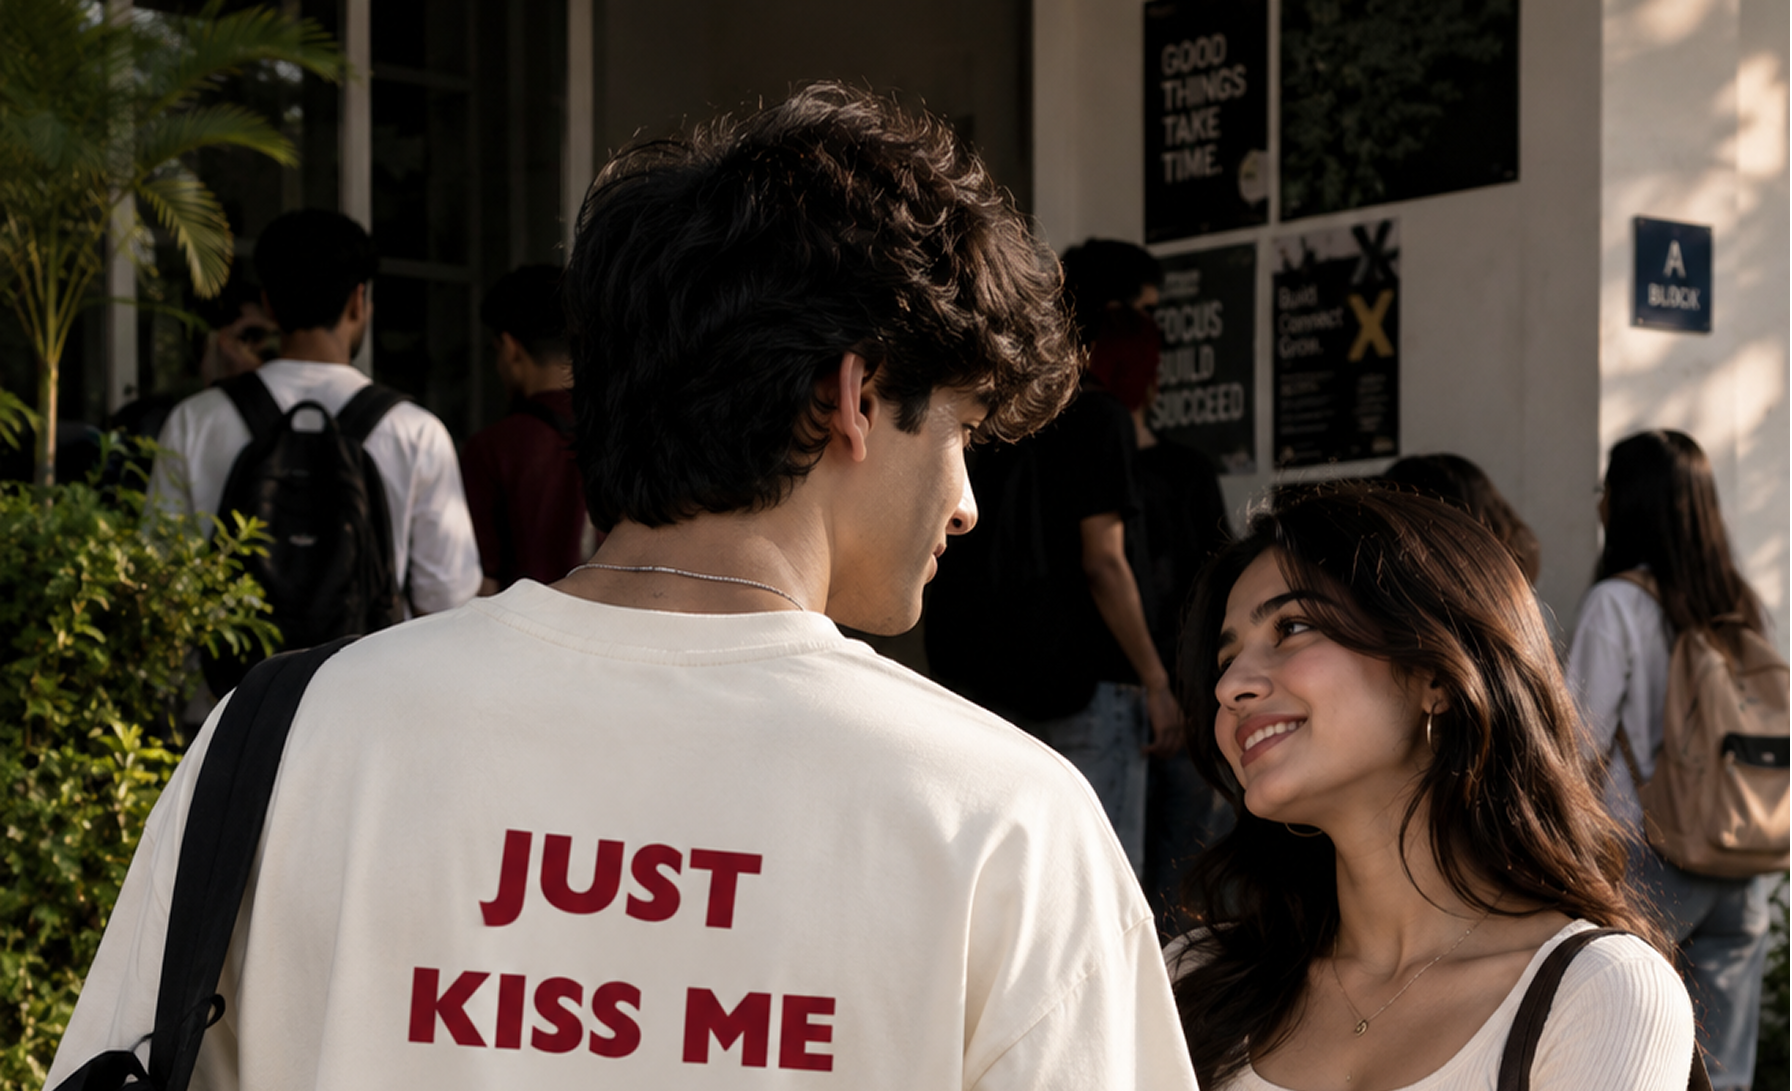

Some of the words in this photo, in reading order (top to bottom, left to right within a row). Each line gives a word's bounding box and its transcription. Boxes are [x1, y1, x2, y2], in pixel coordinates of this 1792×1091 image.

[1161, 32, 1227, 76] GOOD
[1161, 64, 1248, 111] THINGS
[1161, 107, 1222, 147] TAKE
[1161, 144, 1223, 184] TIME.
[1663, 240, 1686, 278] A
[1648, 283, 1701, 310] BLOCK
[1150, 381, 1244, 430] SUCCEED
[479, 829, 762, 929] JUST
[408, 967, 641, 1058] KISS
[682, 987, 835, 1072] ME
